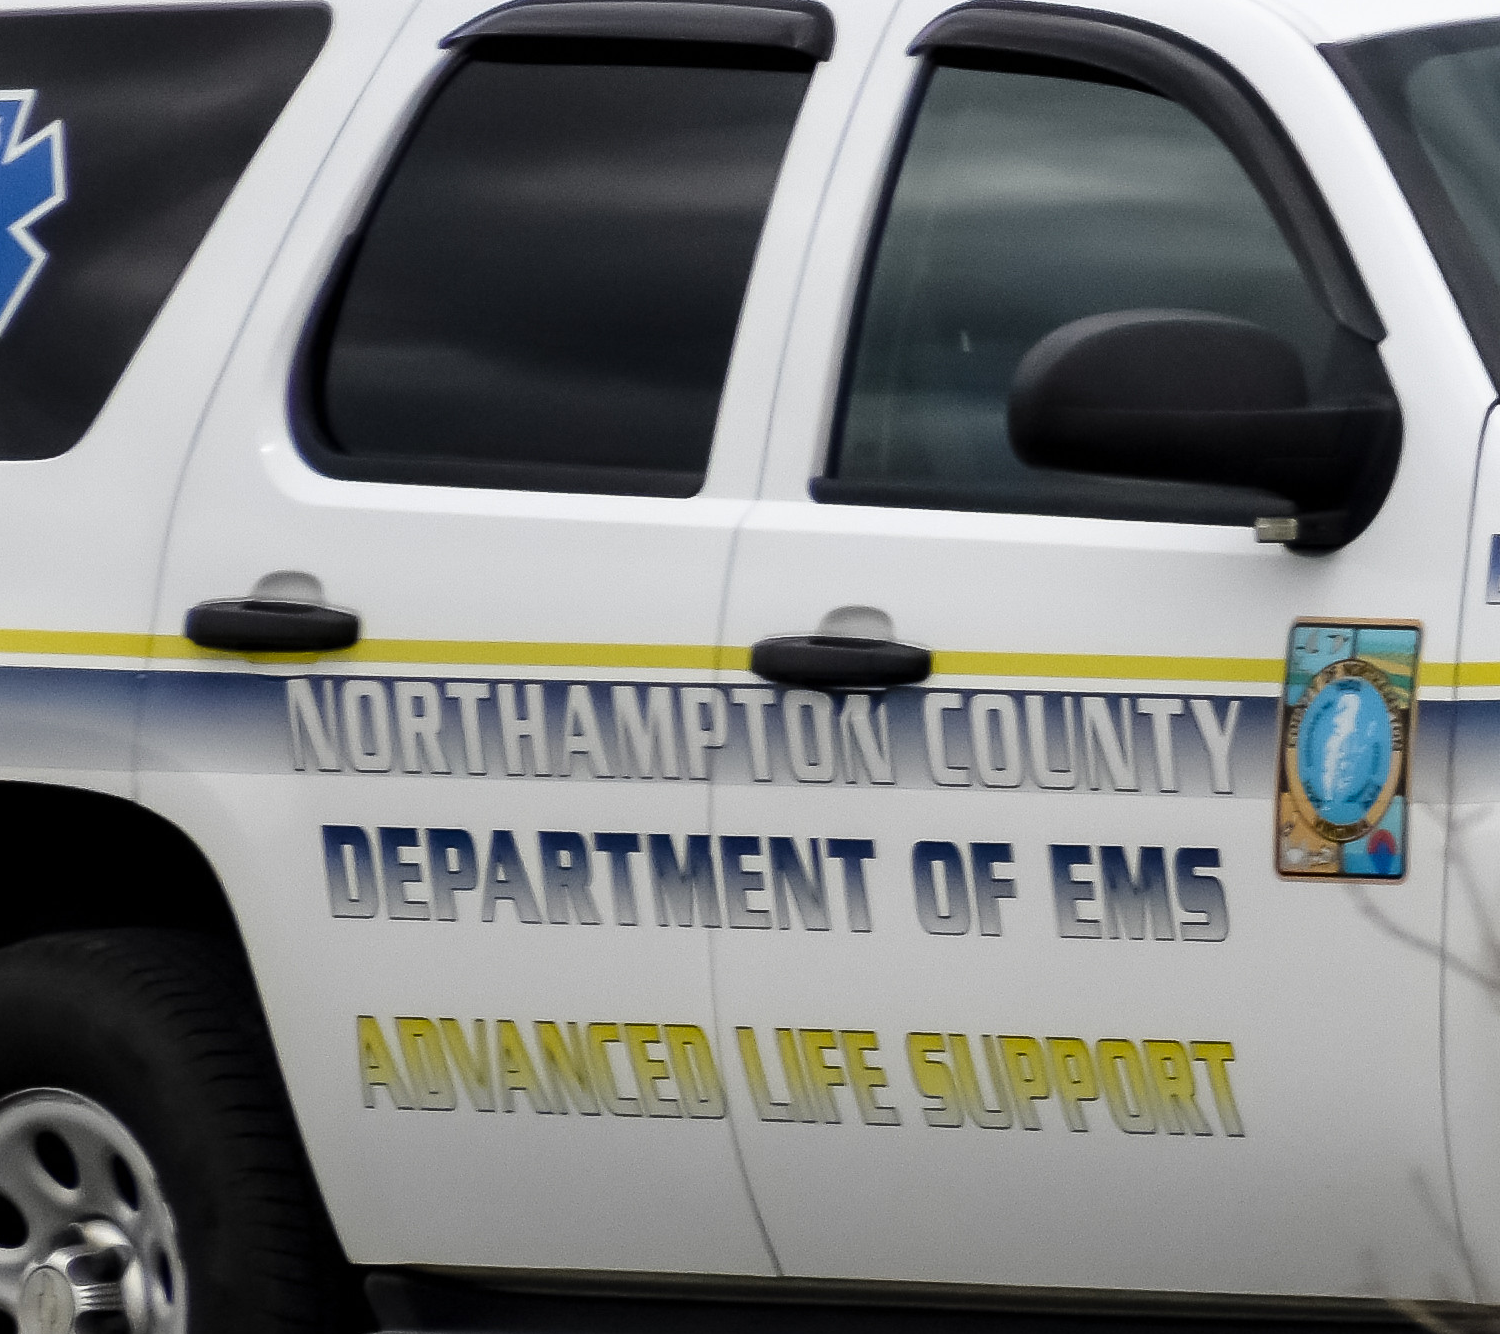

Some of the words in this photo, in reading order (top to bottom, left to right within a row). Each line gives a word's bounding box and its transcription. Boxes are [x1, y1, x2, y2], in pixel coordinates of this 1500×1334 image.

[284, 677, 895, 786] NORTHAMPTON
[923, 692, 1243, 795] COUNTY
[320, 823, 877, 933] DEPARTMENT
[909, 839, 1017, 938] OF
[1046, 843, 1230, 943] EMS
[355, 1014, 728, 1121] ADVANCED
[734, 1025, 902, 1127] LIFE
[906, 1031, 1247, 1139] SUPPORT
